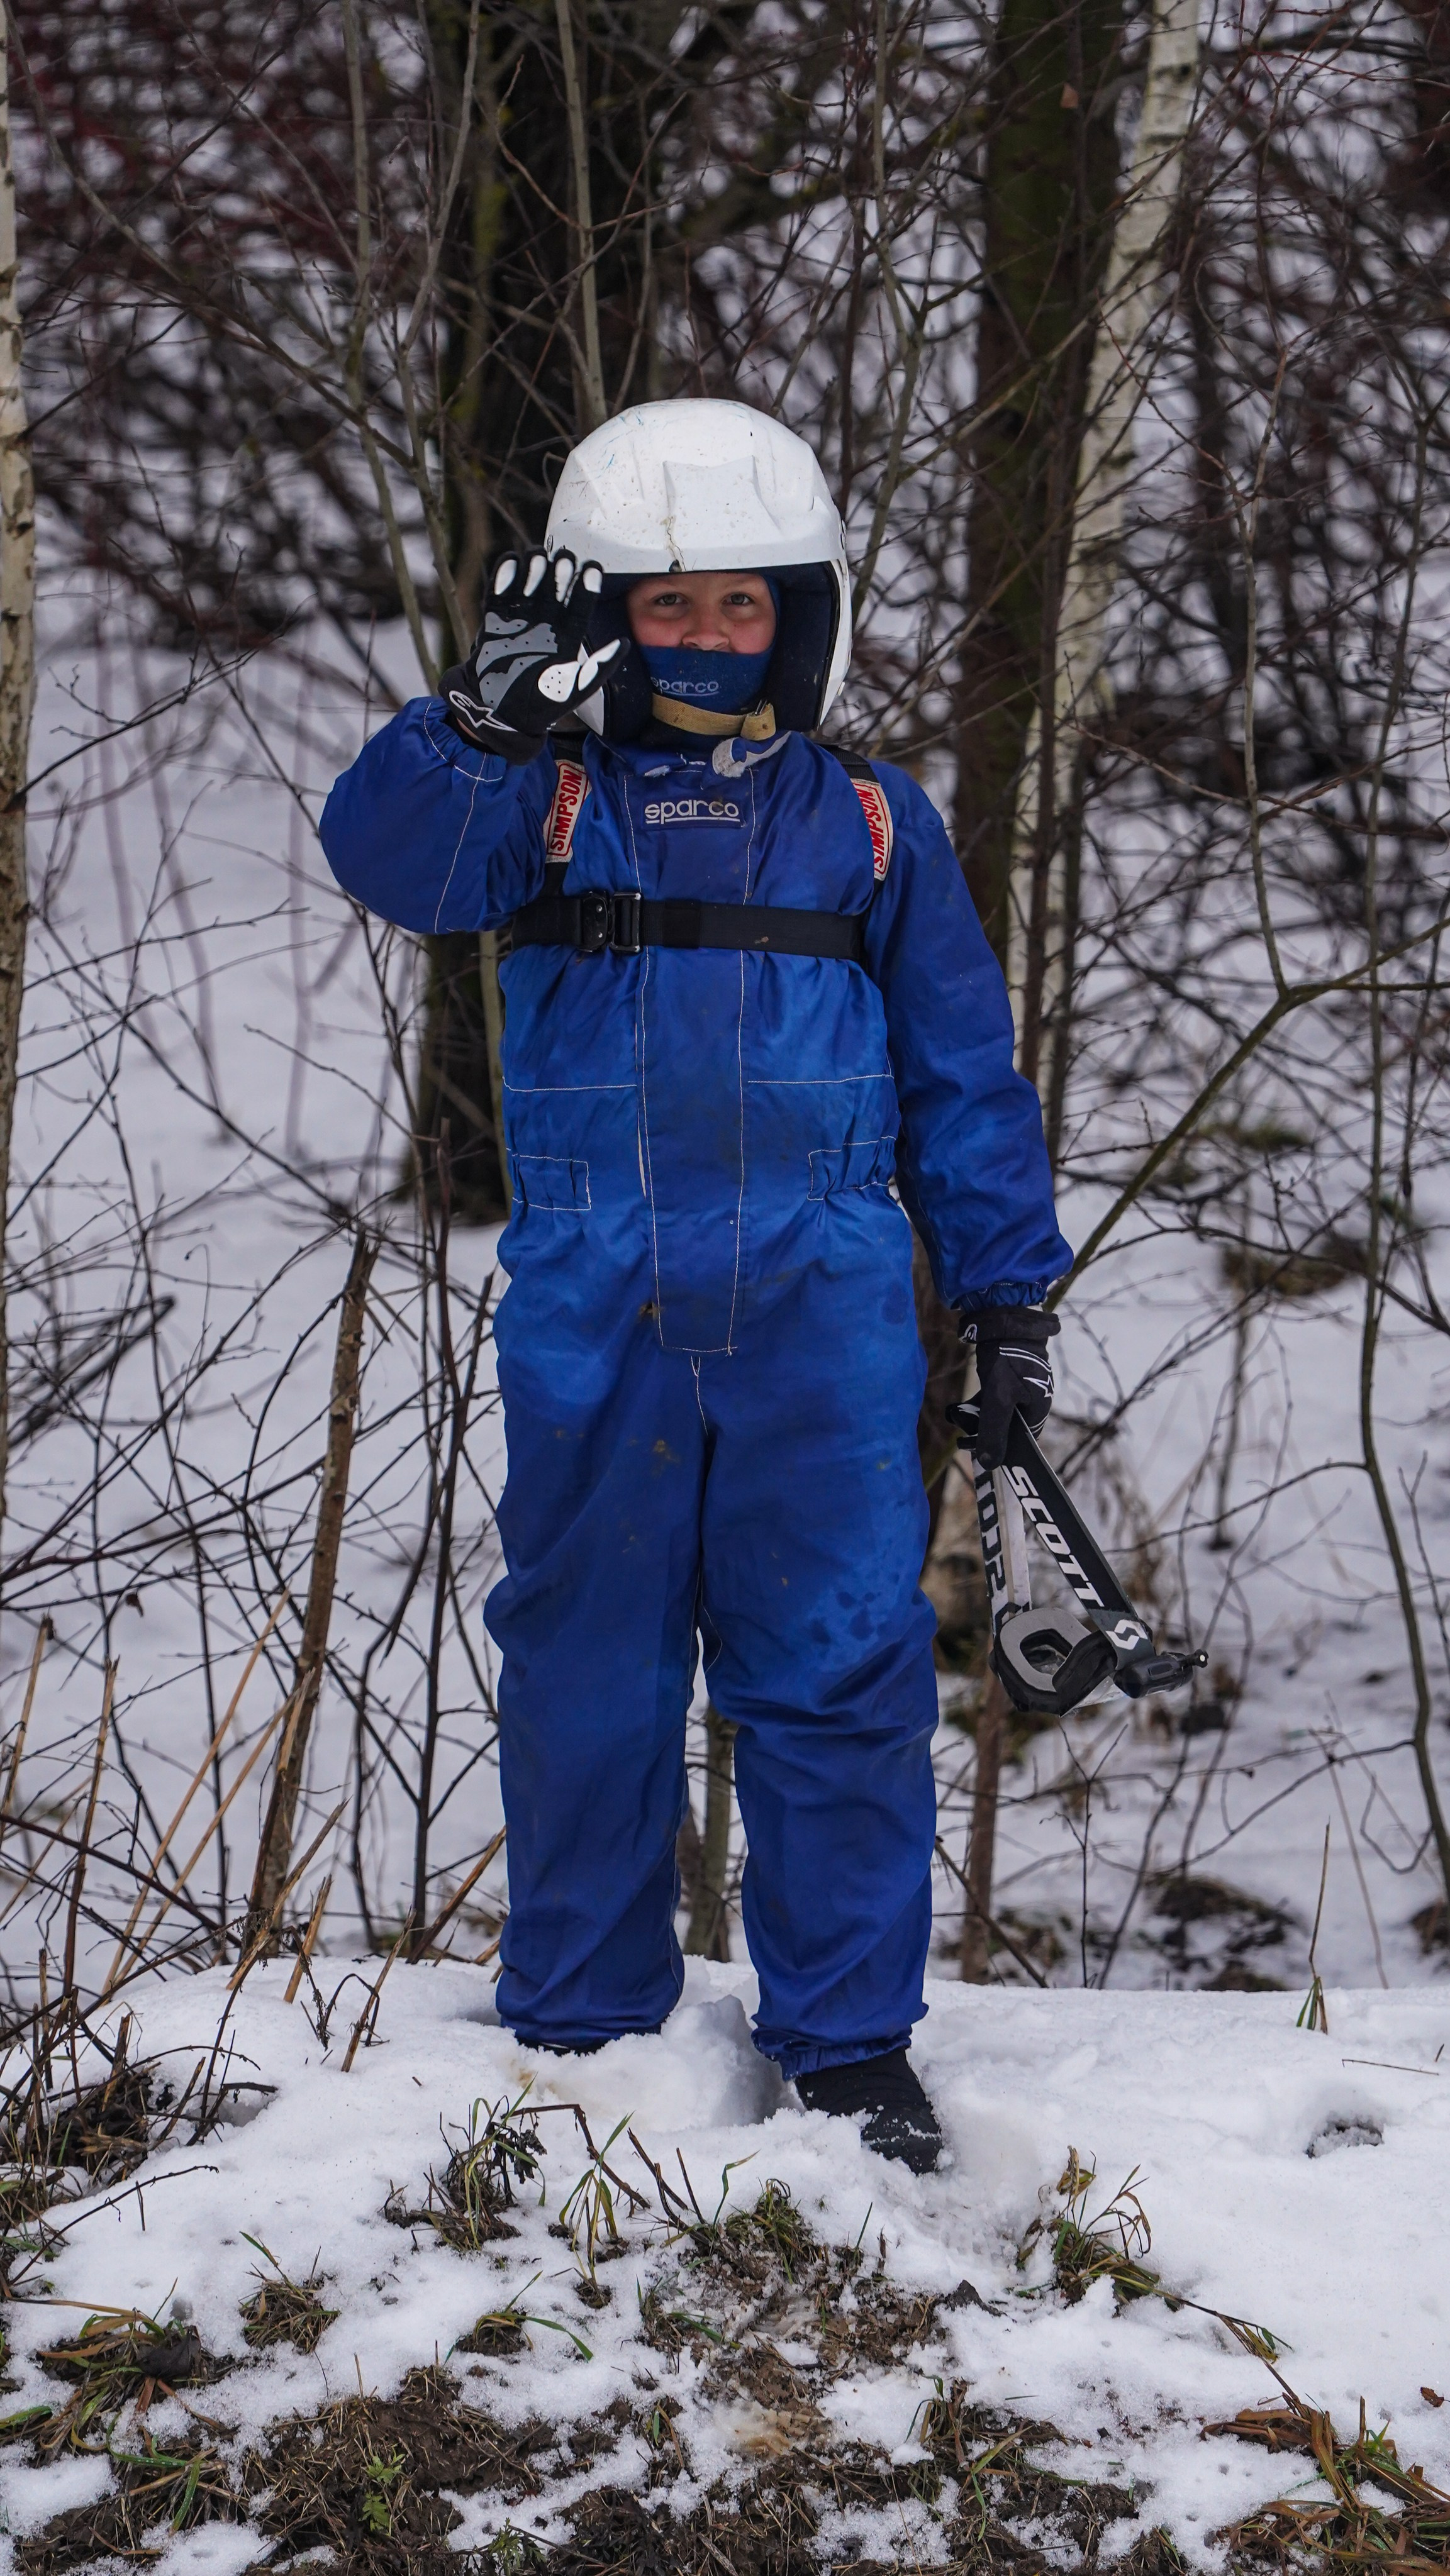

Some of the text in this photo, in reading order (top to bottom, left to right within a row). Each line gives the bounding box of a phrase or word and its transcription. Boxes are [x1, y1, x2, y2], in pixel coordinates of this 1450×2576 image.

[550, 769, 583, 851] SIMPSON
[644, 799, 740, 824] sparco
[1000, 1465, 1105, 1608] SCOTT
